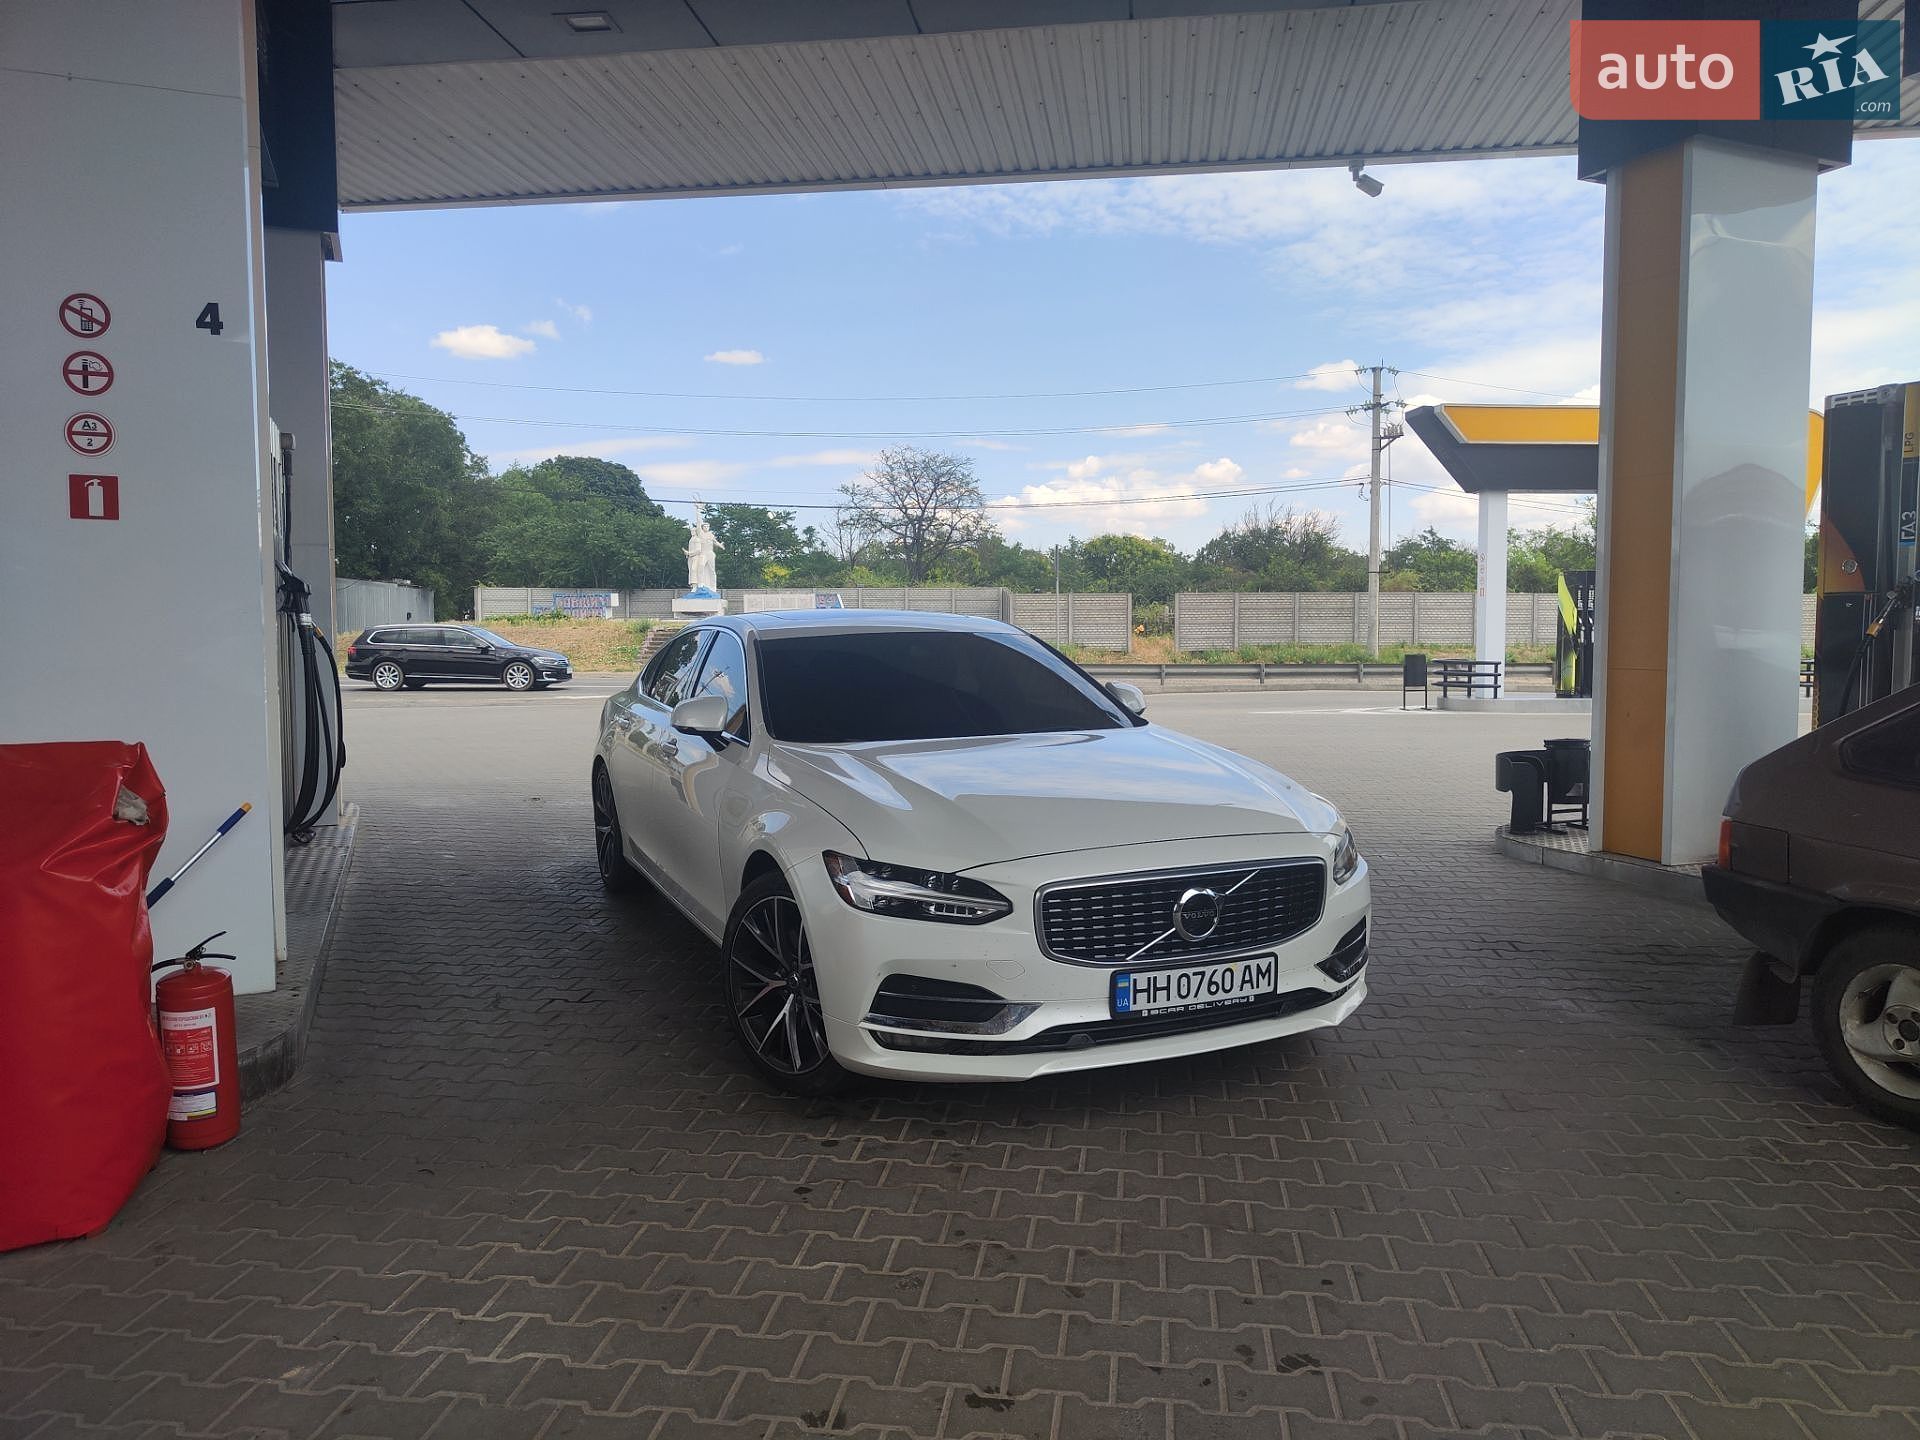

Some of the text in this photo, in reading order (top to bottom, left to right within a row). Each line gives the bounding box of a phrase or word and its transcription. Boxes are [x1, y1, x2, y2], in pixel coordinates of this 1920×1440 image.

[195, 302, 224, 335] 4
[86, 438, 93, 447] 2
[1904, 432, 1914, 453] LPG
[1901, 510, 1916, 540] ГАЗ
[1132, 961, 1272, 1005] HH 0760 AM
[1116, 998, 1129, 1008] UA
[1188, 997, 1248, 1011] DELIVERY
